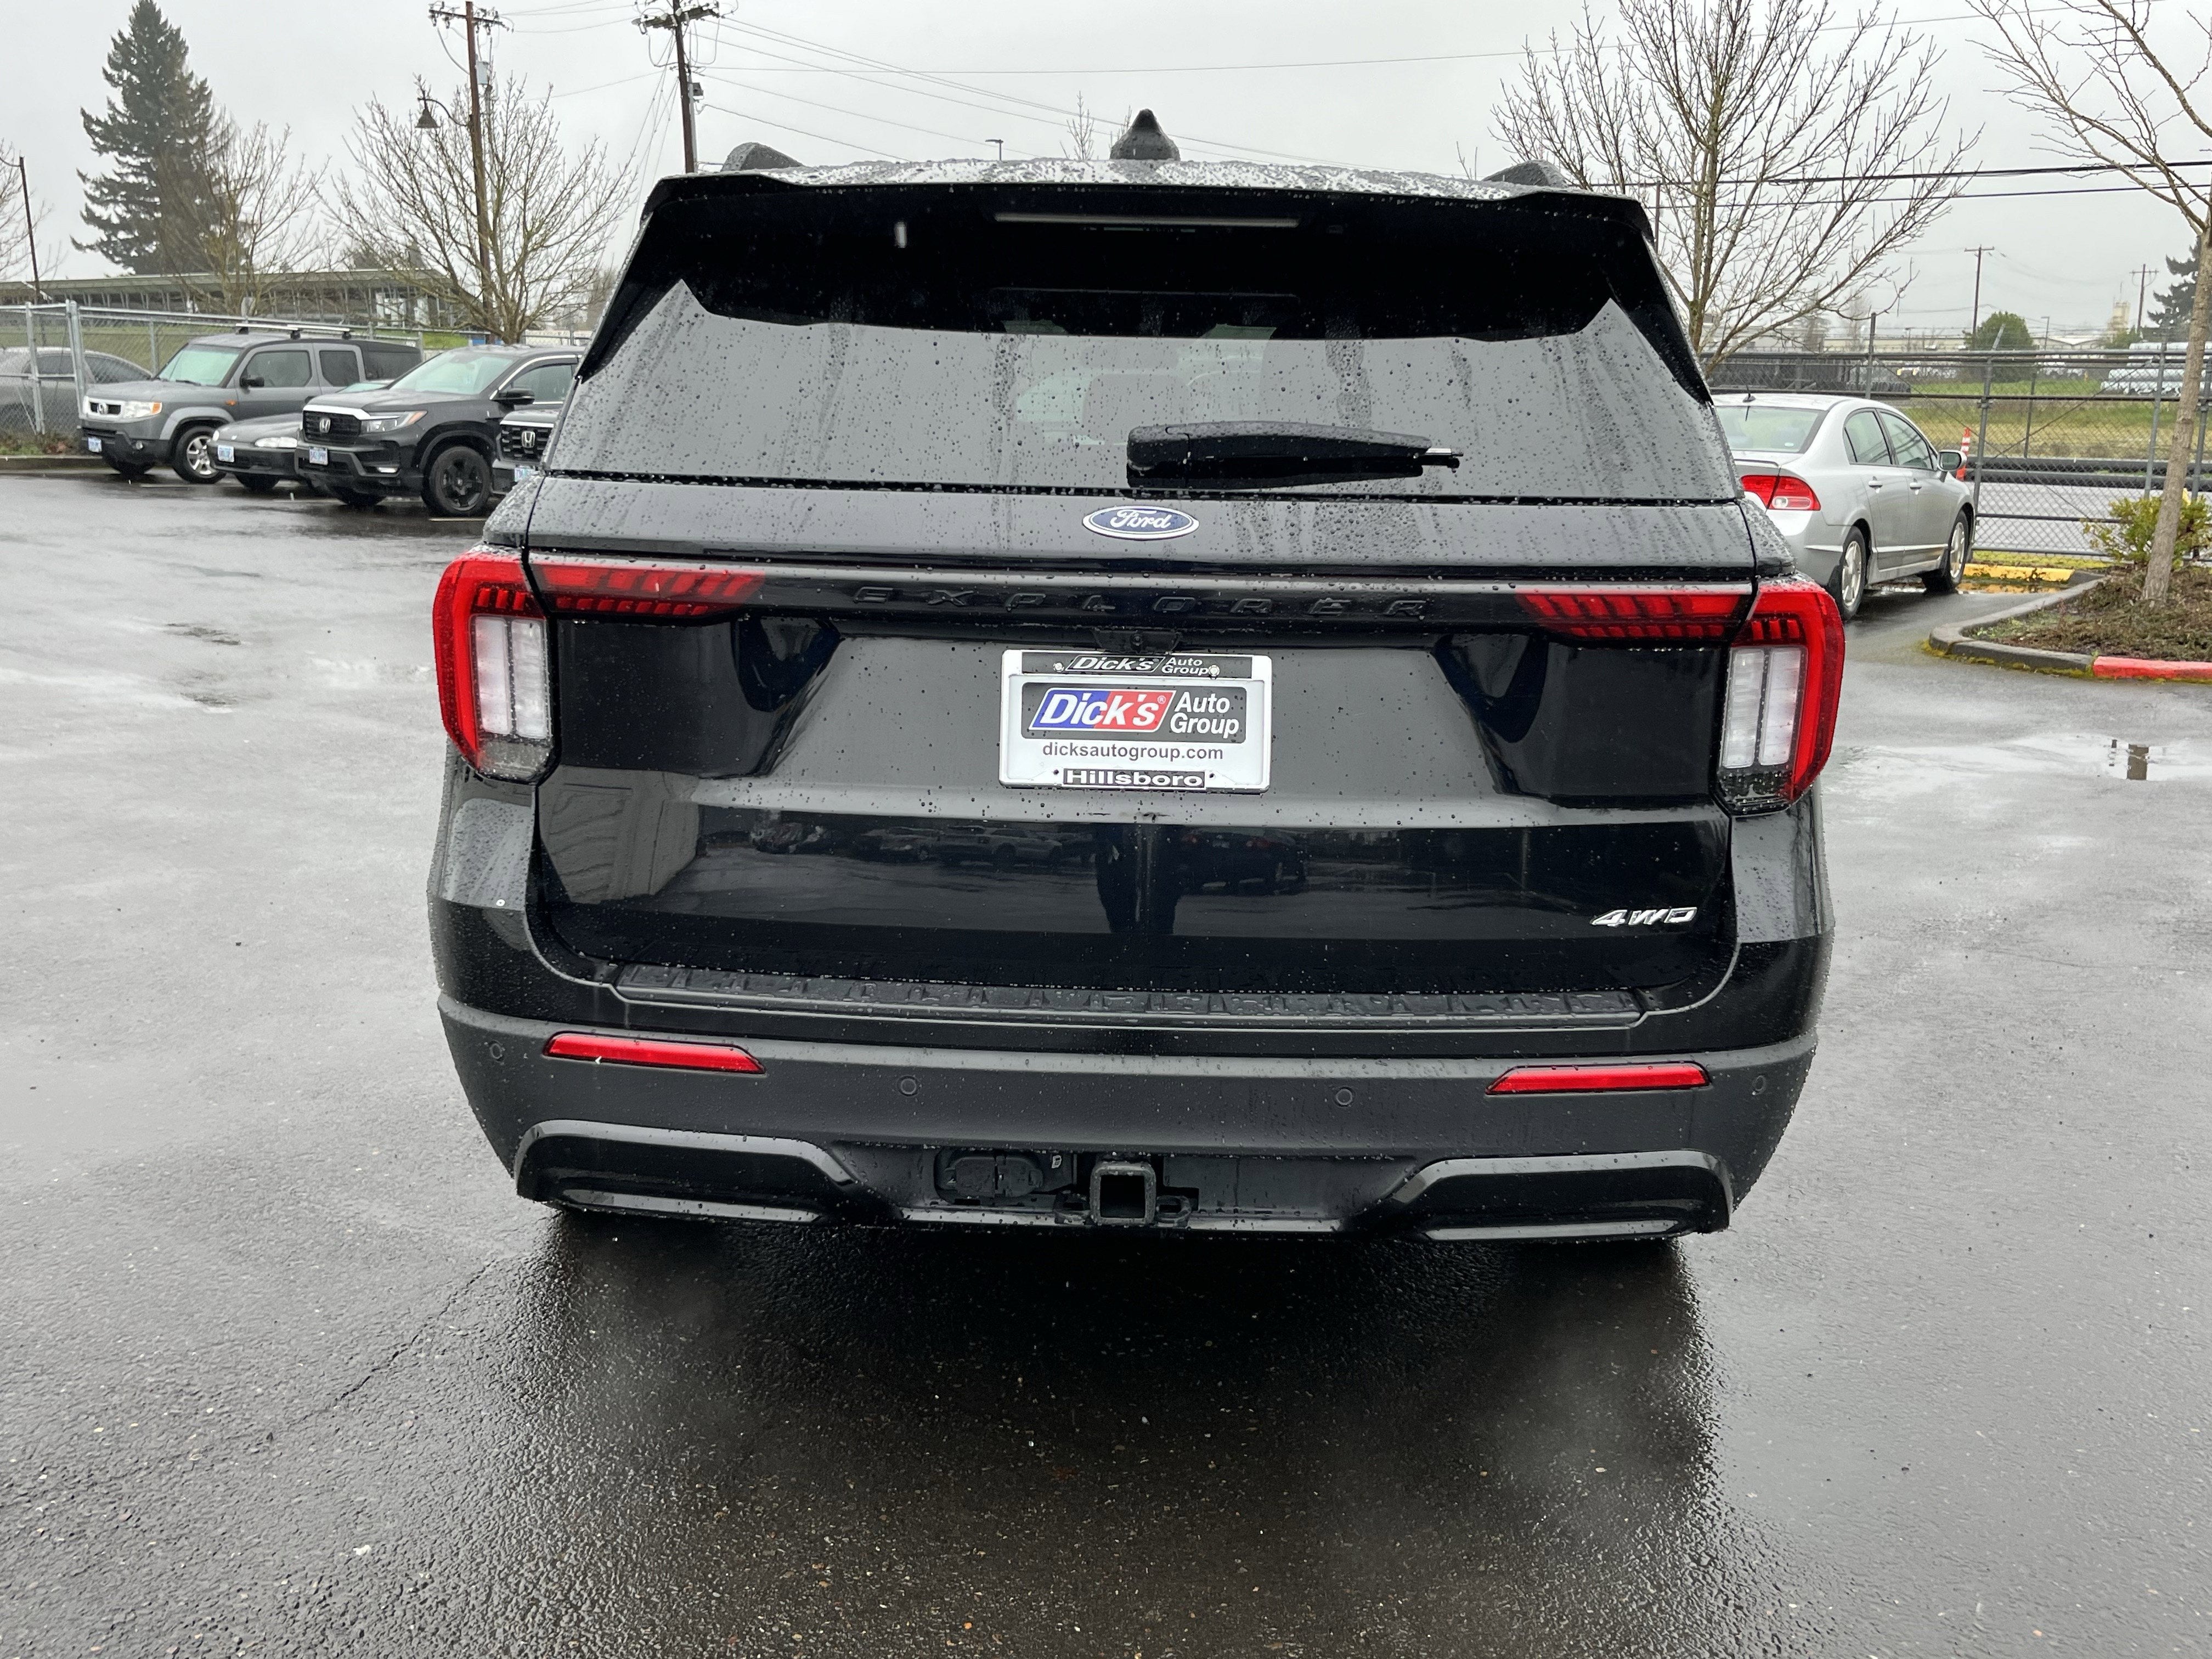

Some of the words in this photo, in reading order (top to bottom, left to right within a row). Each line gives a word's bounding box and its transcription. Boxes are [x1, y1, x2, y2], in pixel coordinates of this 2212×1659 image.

[1109, 509, 1172, 529] Ford
[853, 585, 1426, 617] EXPLORER
[1073, 656, 1154, 671] Dick's
[1161, 665, 1209, 676] Group
[1165, 657, 1203, 667] Auto
[1039, 692, 1159, 726] Dick's
[1174, 691, 1230, 714] Auto
[1170, 712, 1239, 738] Group
[1042, 742, 1223, 762] dicksautogroup.com
[1065, 770, 1204, 787] Hillsboro
[1590, 906, 1697, 927] 4WD
